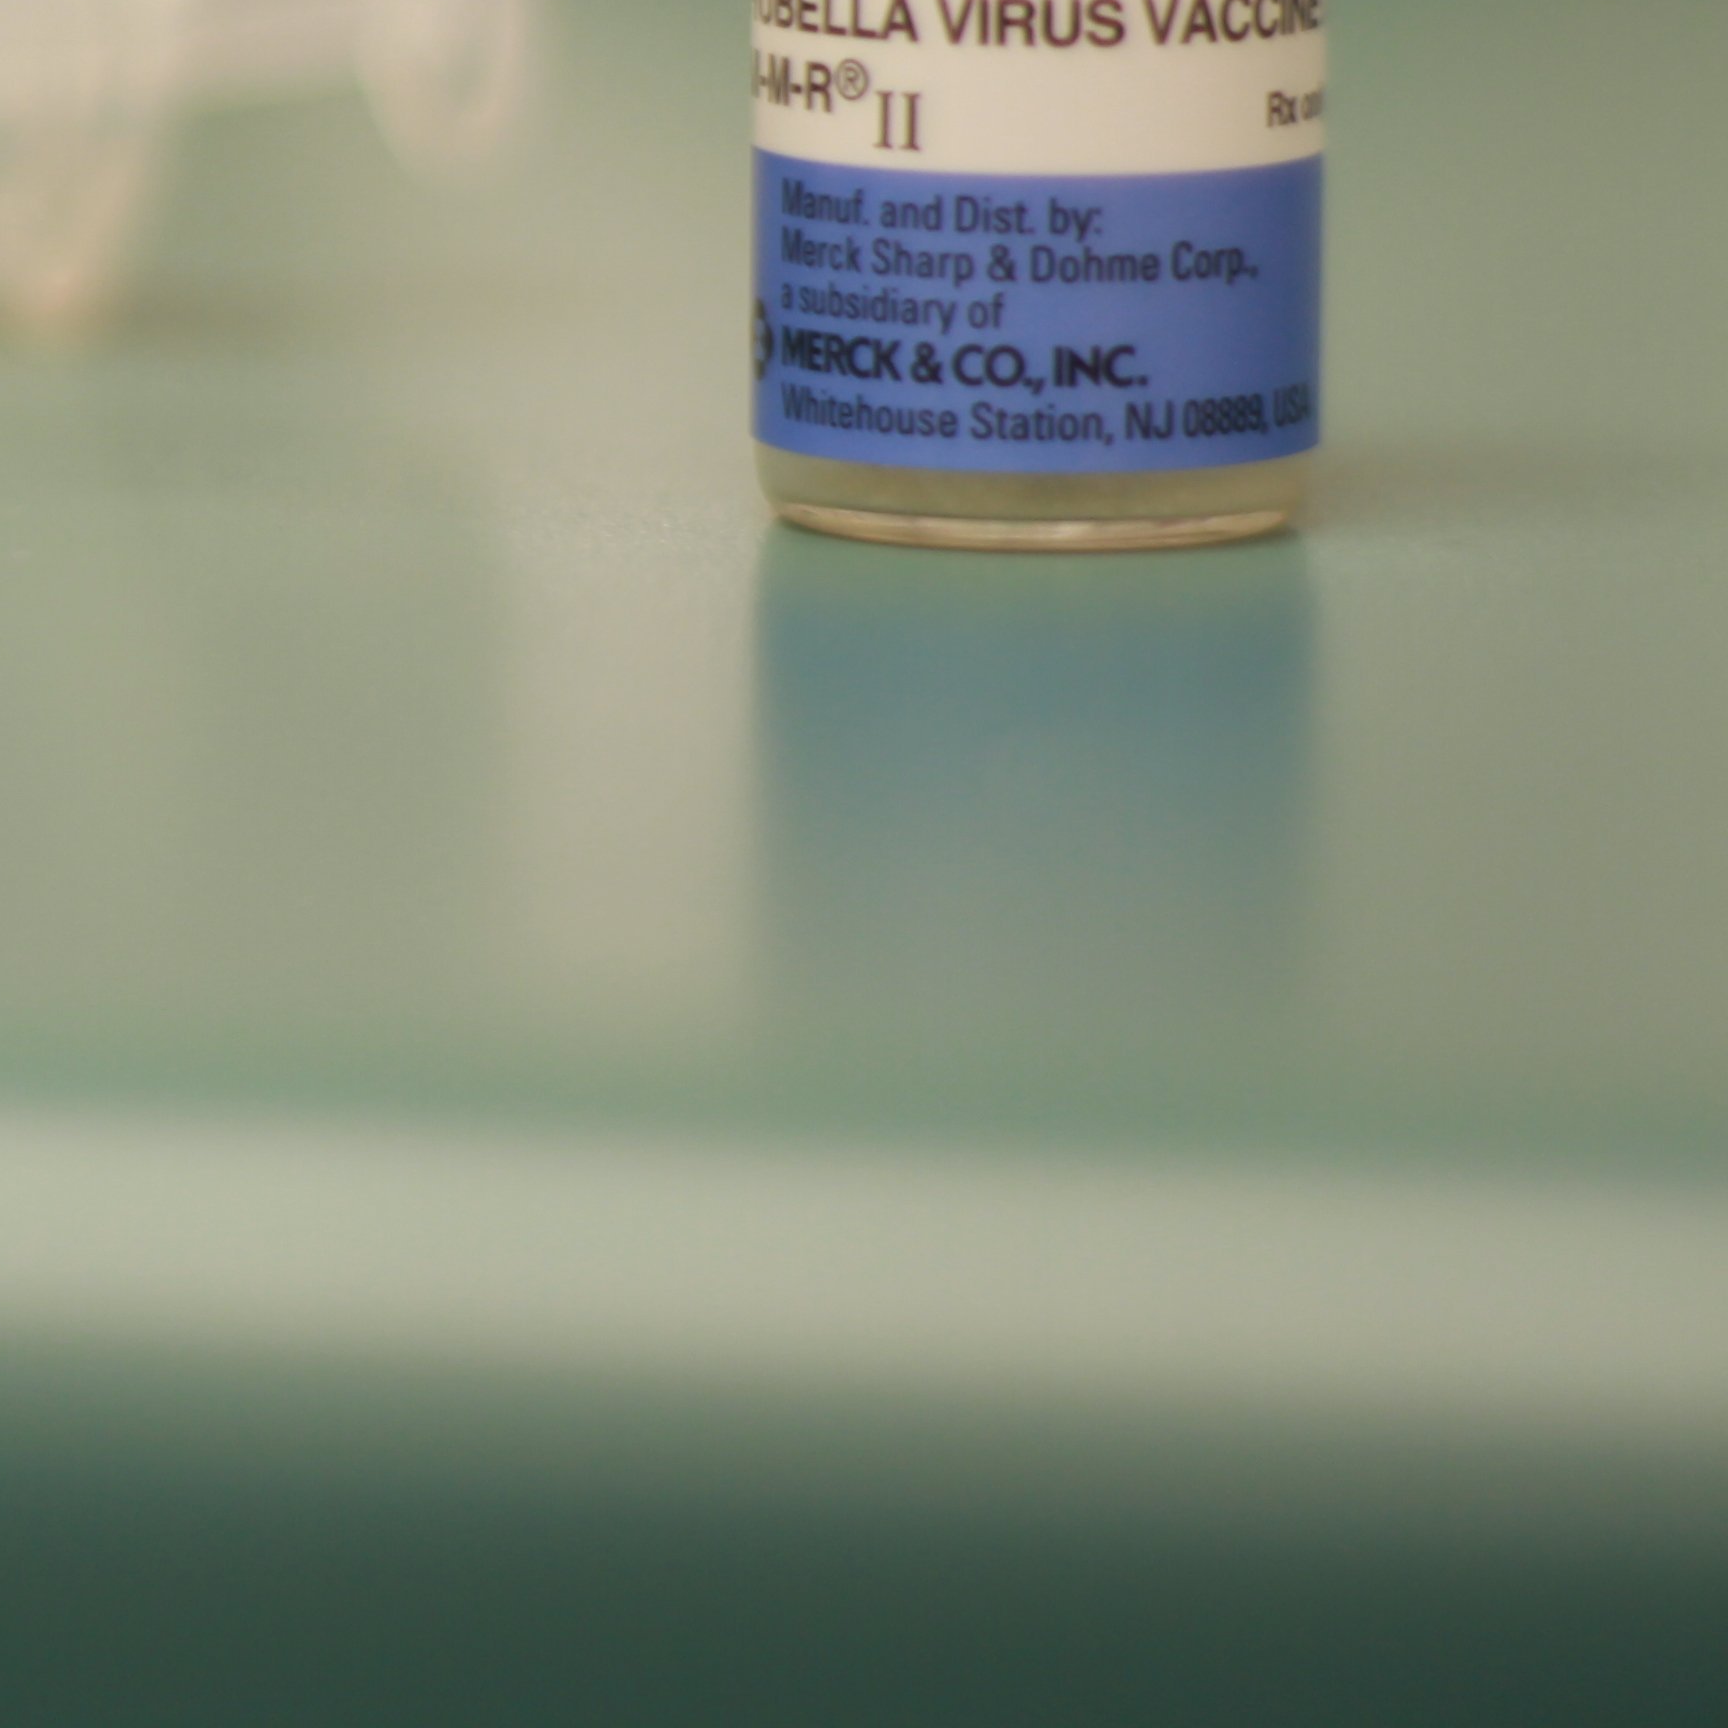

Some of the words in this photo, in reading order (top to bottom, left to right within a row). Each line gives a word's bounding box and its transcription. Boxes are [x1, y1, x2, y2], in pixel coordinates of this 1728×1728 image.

[873, 90, 923, 152] II
[780, 178, 868, 225] Manuf.
[880, 194, 942, 231] and
[953, 194, 1035, 235] Dist.
[1048, 198, 1104, 241] by:
[780, 227, 861, 274] Merck
[871, 235, 975, 287] Sharp
[985, 245, 1018, 283] &
[1029, 242, 1161, 284] Dohme
[780, 286, 795, 312] a
[797, 282, 955, 335] subsidiary
[966, 291, 1004, 330] of
[780, 326, 903, 382] MERCK
[911, 344, 941, 383] &
[950, 342, 1042, 395] CO.,
[1052, 344, 1148, 388] INC.
[780, 382, 957, 439] Whitehouse
[969, 402, 1115, 446] Station,
[1125, 400, 1175, 441] NJ
